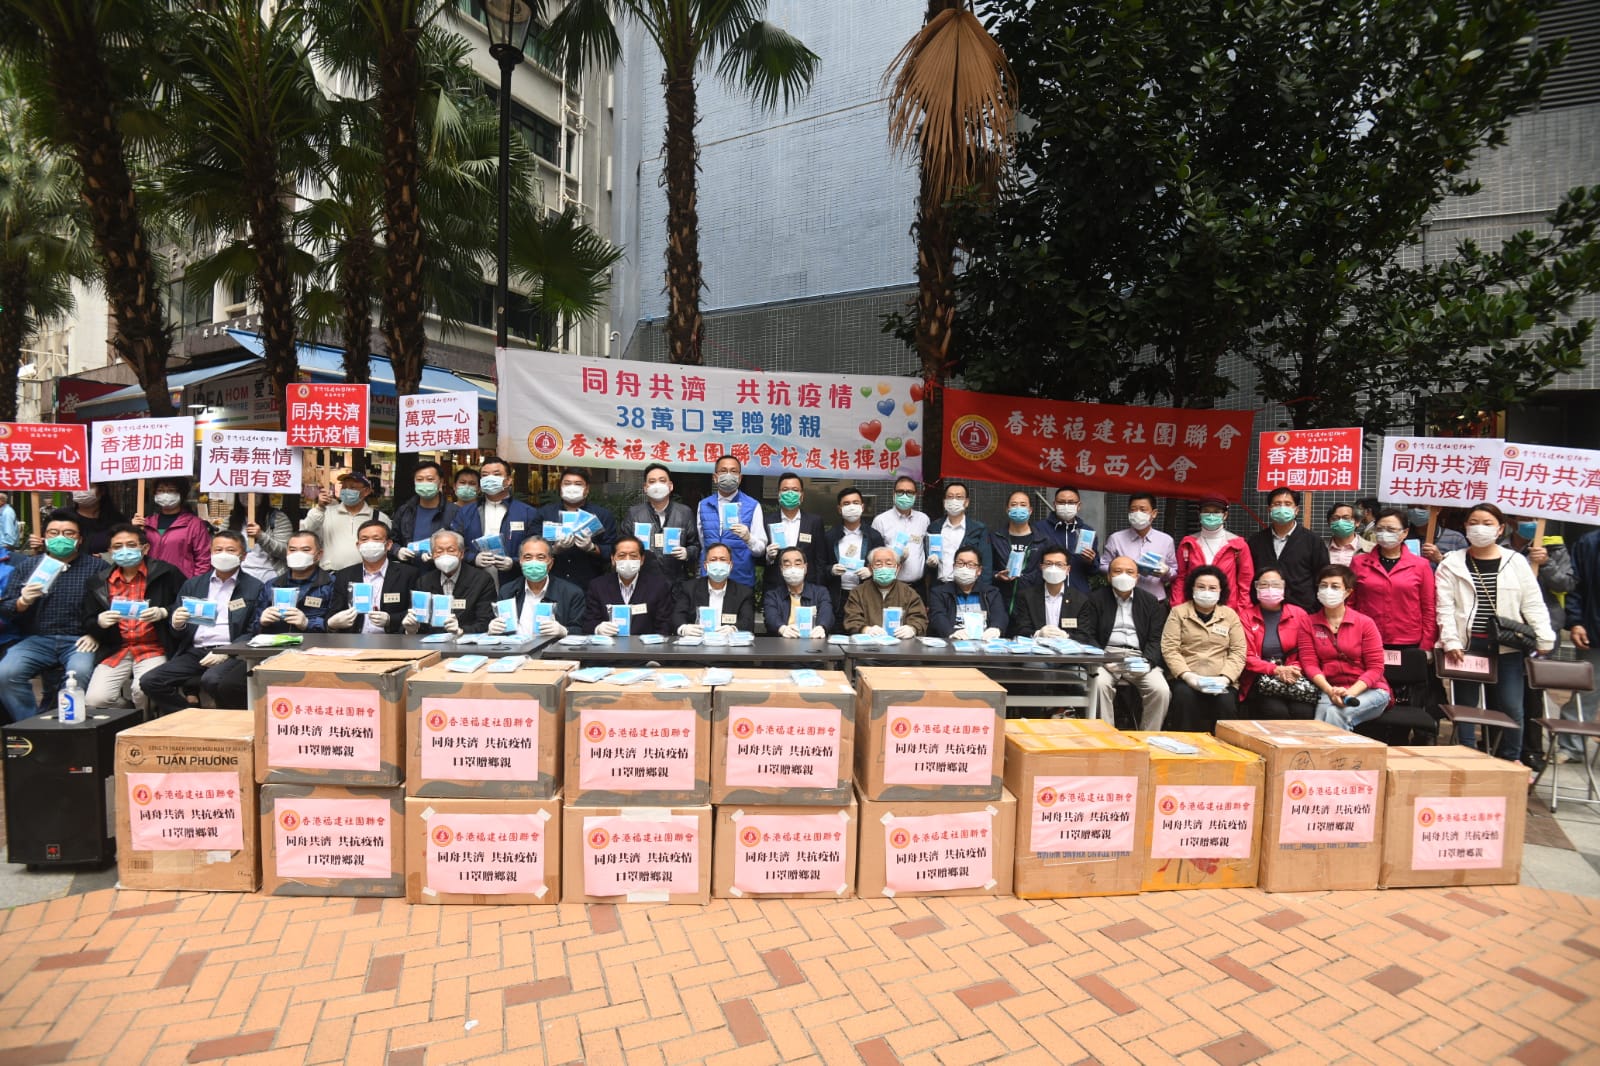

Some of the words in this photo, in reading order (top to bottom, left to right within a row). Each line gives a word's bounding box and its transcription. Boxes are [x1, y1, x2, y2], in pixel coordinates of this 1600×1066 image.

[582, 368, 705, 401] 同舟共濟
[737, 379, 851, 408] 共抗疫情
[292, 402, 360, 421] 同舟共濟
[406, 409, 469, 429] 萬眾一心
[617, 405, 820, 439] 38萬口罩贈鄉親
[292, 425, 360, 444] 共抗疫情
[1005, 411, 1241, 449] 香港福建社團聯會
[102, 431, 183, 455] 香港加油
[407, 429, 469, 446] 共克時艱
[210, 444, 294, 465] 病毒無情
[568, 436, 900, 472] 香港福建社團聯會抗疫指揮部
[1268, 442, 1352, 464] 香港加油
[100, 451, 183, 473] 中國加油
[1039, 447, 1198, 482] 港島西分會
[1392, 453, 1491, 474] 同舟共濟
[211, 469, 291, 487] 人間有愛
[1267, 467, 1351, 486] 中國加油
[1500, 461, 1600, 491] 同舟共濟
[1390, 477, 1488, 501] 共抗疫情
[1496, 486, 1600, 516] 共抗疫情
[278, 725, 322, 736] 同舟共濟
[330, 727, 373, 738] 共抗疫情
[433, 737, 478, 748] 同舟共濟
[486, 738, 531, 748] 共抗疫情
[299, 745, 353, 757] 口罩贈鄉親
[591, 748, 636, 758] 同舟共濟
[644, 748, 688, 759] 共抗疫情
[738, 744, 782, 755] 同舟共濟
[791, 746, 832, 756] 共抗疫情
[896, 744, 938, 753] 同舟共濟
[946, 744, 986, 755] 共抗疫情
[454, 757, 511, 767] 口罩贈鄉親
[915, 762, 967, 772] 口罩贈鄉親
[612, 767, 668, 777] 口罩贈鄉親
[758, 765, 813, 775] 口罩贈鄉親
[140, 809, 184, 820] 同舟共濟
[192, 809, 234, 819] 共抗疫情
[1292, 805, 1329, 814] 同舟共濟
[1336, 804, 1370, 814] 共抗疫情
[1042, 812, 1083, 822] 同舟共濟
[1091, 812, 1129, 821] 共抗疫情
[1163, 820, 1202, 830] 同舟共濟
[1210, 820, 1247, 830] 共抗疫情
[1308, 822, 1354, 831] 口罩贈鄉親
[163, 827, 218, 838] 口罩贈鄉親
[1061, 830, 1110, 840] 口罩贈鄉親
[287, 836, 331, 846] 同舟共濟
[340, 836, 383, 846] 共抗疫情
[1181, 837, 1229, 847] 口罩贈鄉親
[308, 855, 364, 865] 口罩贈鄉親
[438, 852, 484, 862] 同舟共濟
[492, 852, 536, 863] 共抗疫情
[595, 853, 640, 864] 同舟共濟
[648, 852, 691, 863] 共抗疫情
[746, 852, 789, 862] 同舟共濟
[797, 851, 839, 862] 共抗疫情
[897, 851, 938, 864] 同舟共濟
[946, 848, 986, 859] 共抗疫情
[460, 871, 517, 881] 口罩贈鄉親
[617, 871, 672, 881] 口罩贈鄉親
[766, 870, 820, 880] 口罩贈鄉親
[917, 867, 968, 879] 口罩贈鄉親
